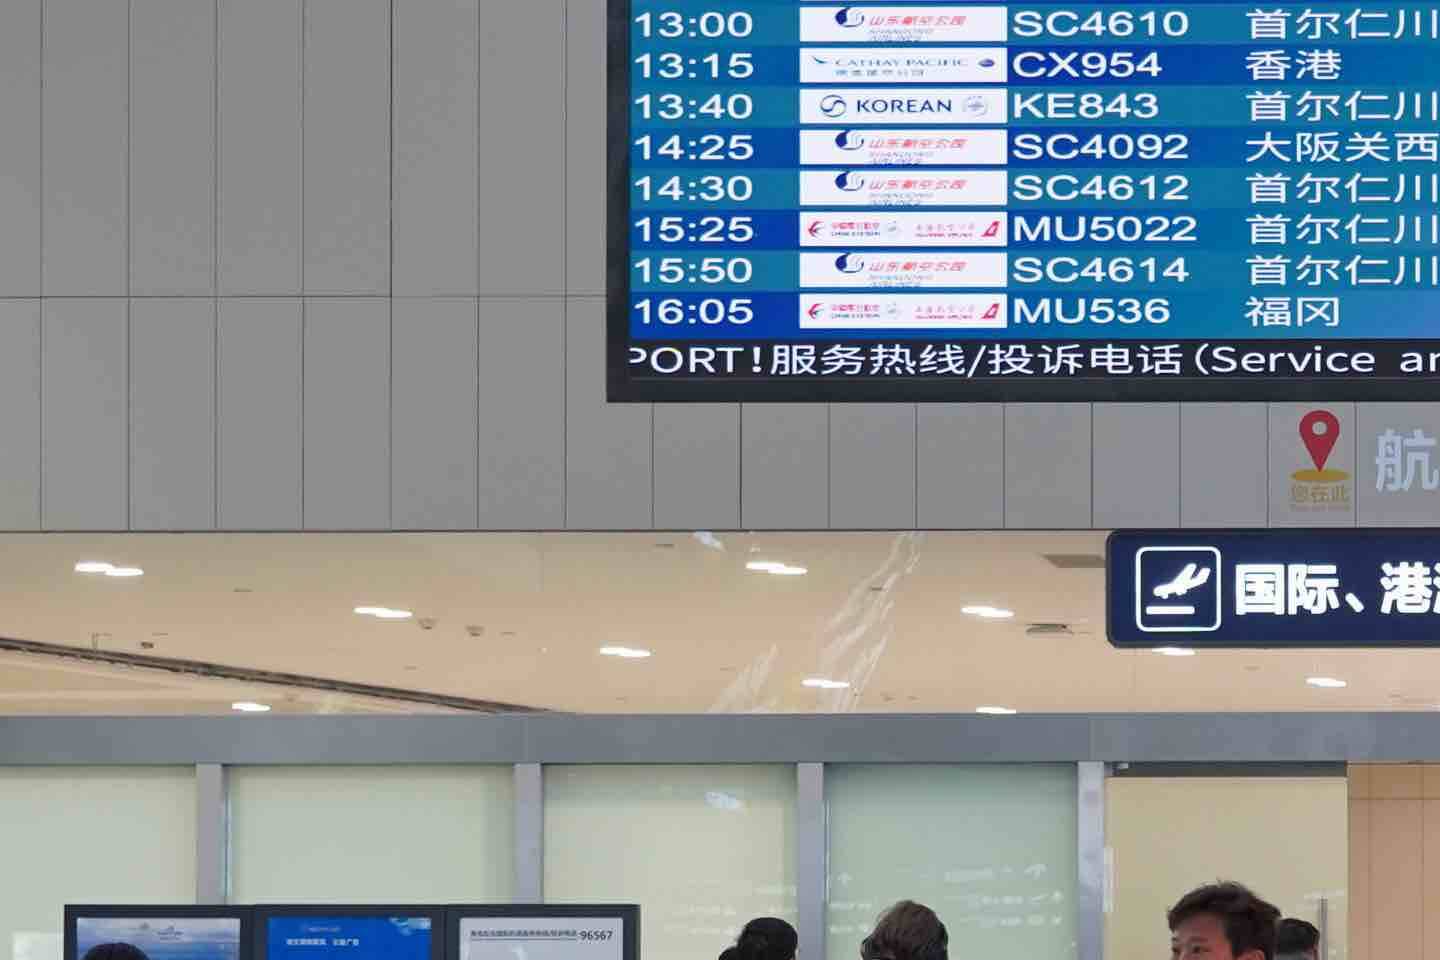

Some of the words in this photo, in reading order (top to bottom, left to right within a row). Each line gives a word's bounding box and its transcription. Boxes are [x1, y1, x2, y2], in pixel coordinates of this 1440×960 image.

[635, 11, 753, 38] 13:00
[1013, 10, 1189, 37] SC4610
[1246, 8, 1438, 39] 首尔仁川
[635, 52, 754, 78] 13:15
[1013, 51, 1162, 78] CX954
[1245, 49, 1342, 81] 香港
[635, 94, 753, 119] 13:40
[856, 98, 952, 114] KOREAN
[1013, 93, 1159, 119] KE843
[1246, 90, 1438, 122] 首尔仁川
[635, 134, 754, 160] 14:25
[1013, 133, 1188, 160] SC4092
[1246, 131, 1440, 162] 大阪关西
[635, 175, 753, 201] 14:30
[1013, 174, 1188, 201] SC4612
[1246, 172, 1438, 204] 首尔仁川
[635, 216, 753, 242] 15:25
[1014, 216, 1197, 242] MU5022
[1246, 213, 1438, 245] 首尔仁川
[635, 257, 753, 284] 15:50
[1013, 256, 1190, 283] SC4614
[1246, 254, 1438, 286] 首尔仁川
[634, 298, 753, 325] 16:05
[1014, 298, 1170, 324] MU536
[1245, 296, 1340, 327] 福冈
